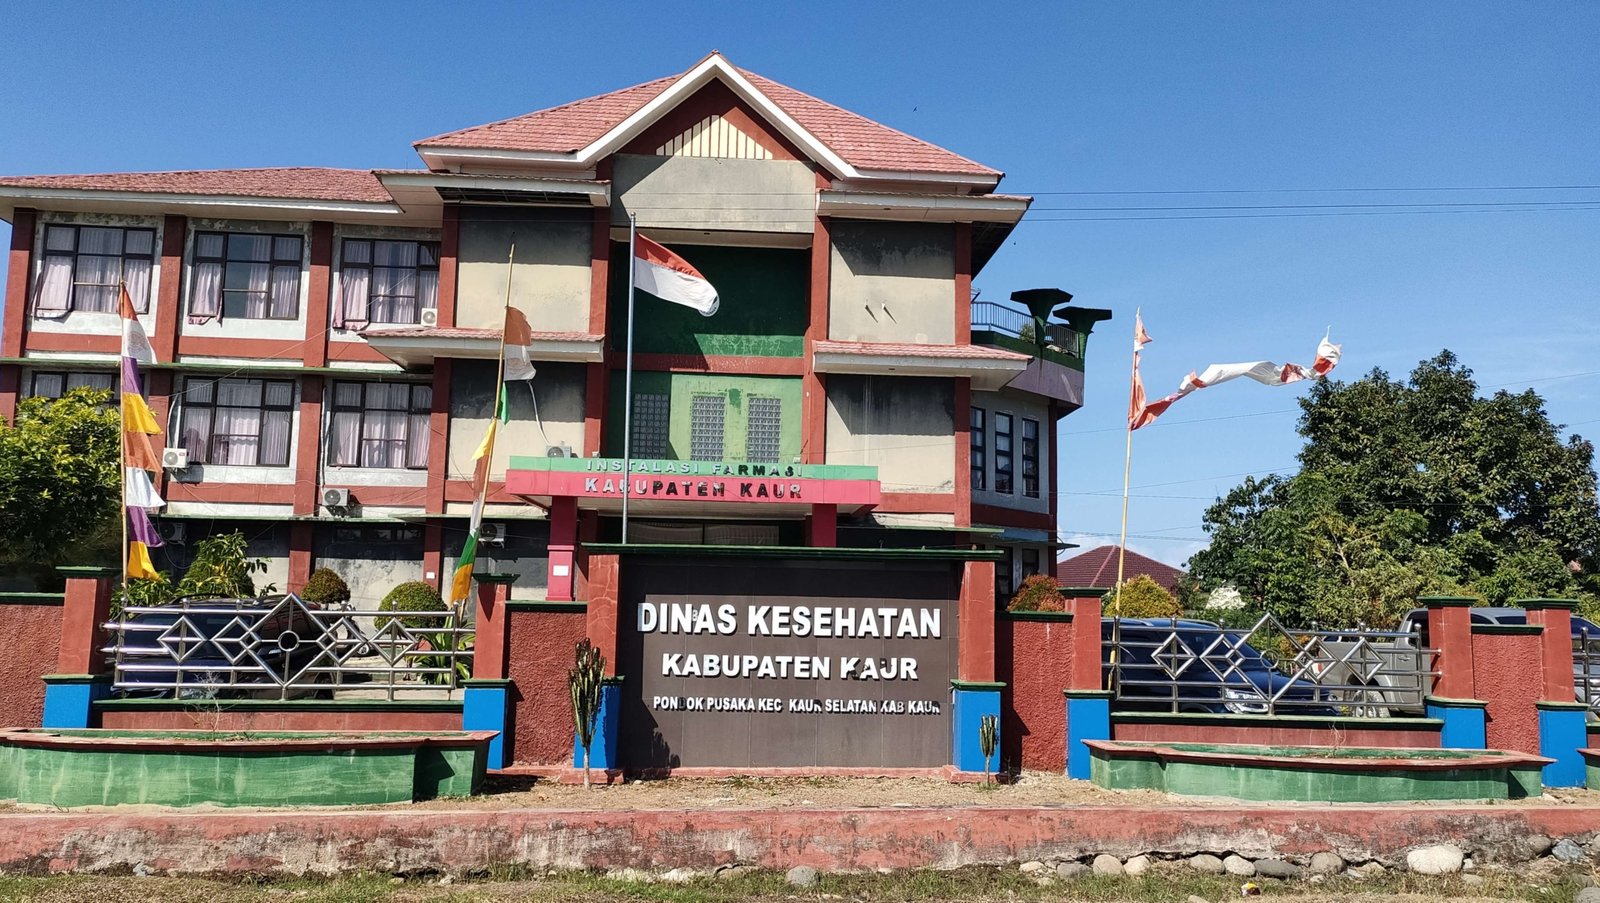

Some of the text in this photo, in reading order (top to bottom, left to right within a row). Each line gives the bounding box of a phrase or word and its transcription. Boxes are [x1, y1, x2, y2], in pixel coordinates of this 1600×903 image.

[587, 459, 802, 477] INSTALASI FARMASI
[740, 482, 802, 499] KAUR
[637, 602, 941, 638] DINAS KESEHATAN
[662, 653, 918, 680] KABUPATEN KAUR
[707, 696, 755, 711] PUSAKA
[758, 697, 783, 712] KEC
[825, 698, 877, 713] SELATAN
[880, 699, 905, 713] KAB
